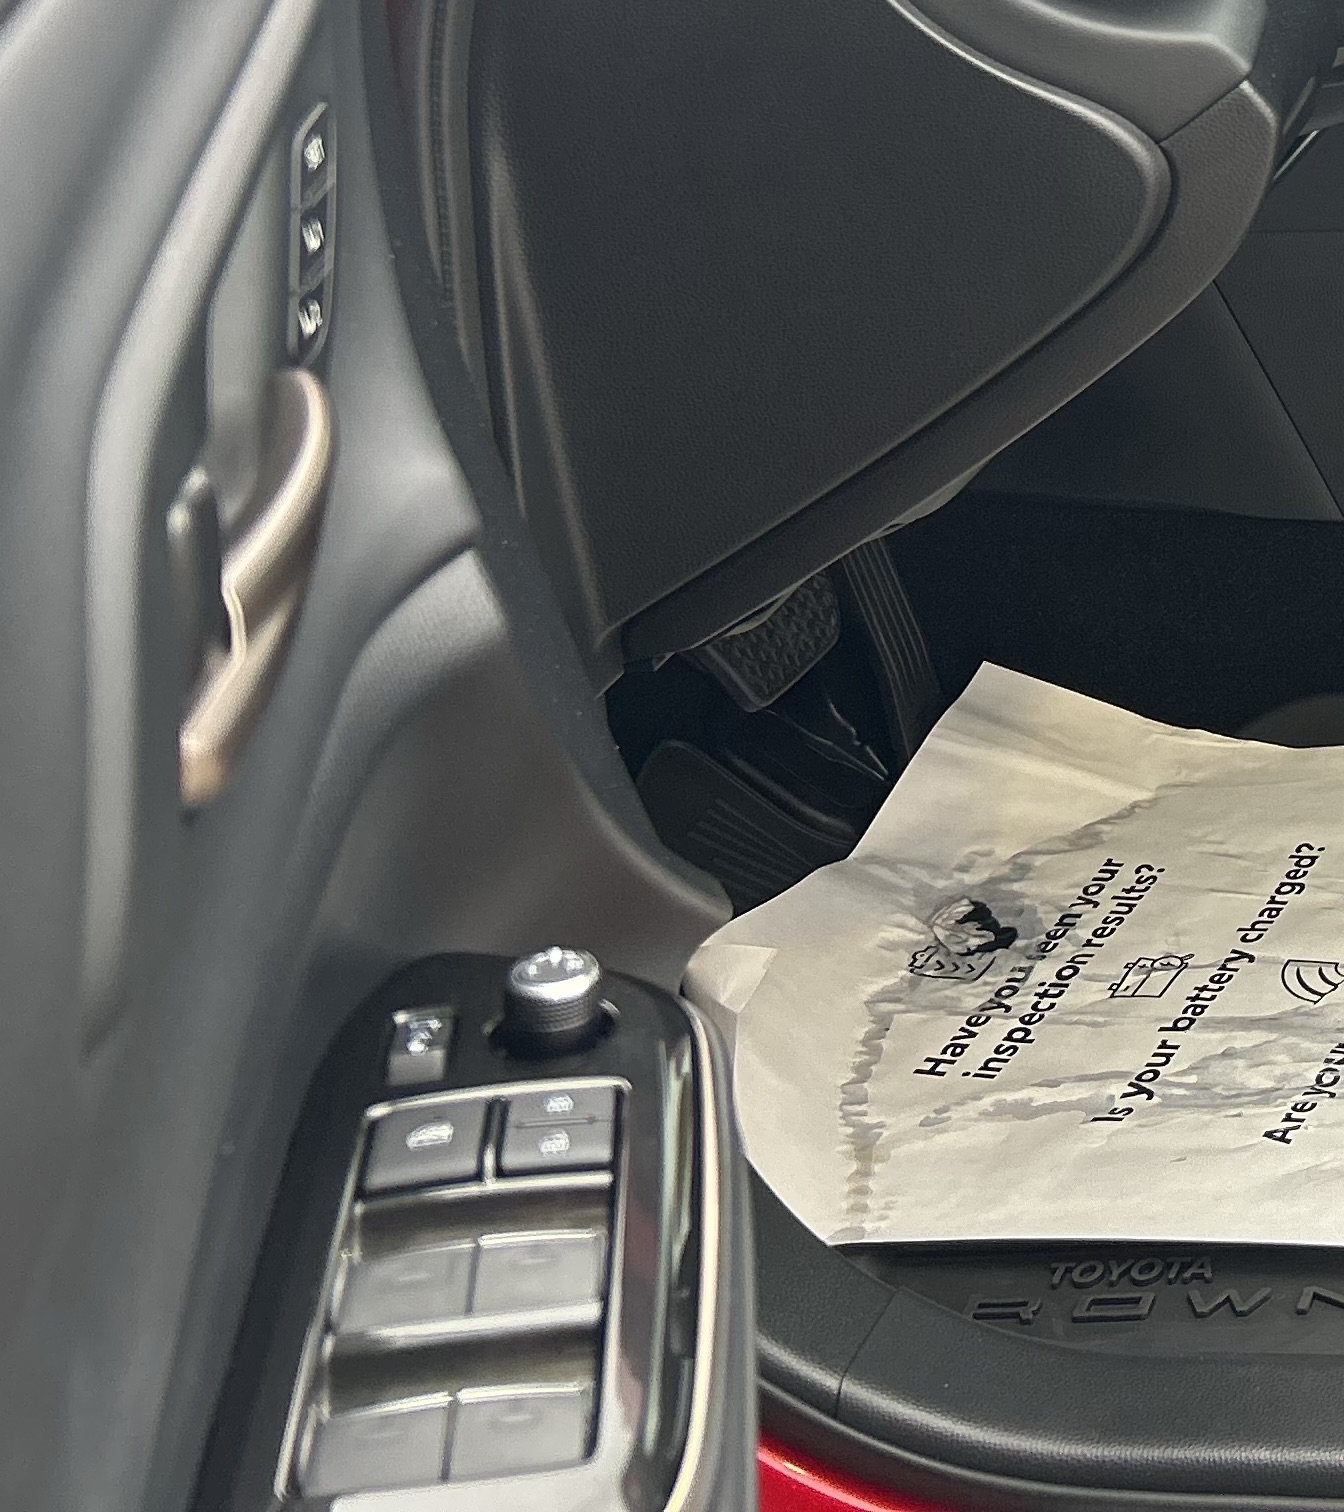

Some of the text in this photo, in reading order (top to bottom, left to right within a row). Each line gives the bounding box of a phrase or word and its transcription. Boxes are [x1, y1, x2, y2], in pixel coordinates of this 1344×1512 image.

[914, 858, 1124, 1076] Have you een your
[962, 864, 1164, 1079] inspection results?
[1091, 843, 1325, 1121] Is your battery charged?
[1263, 1102, 1317, 1144] Are
[1049, 1256, 1216, 1288] TOYOTA
